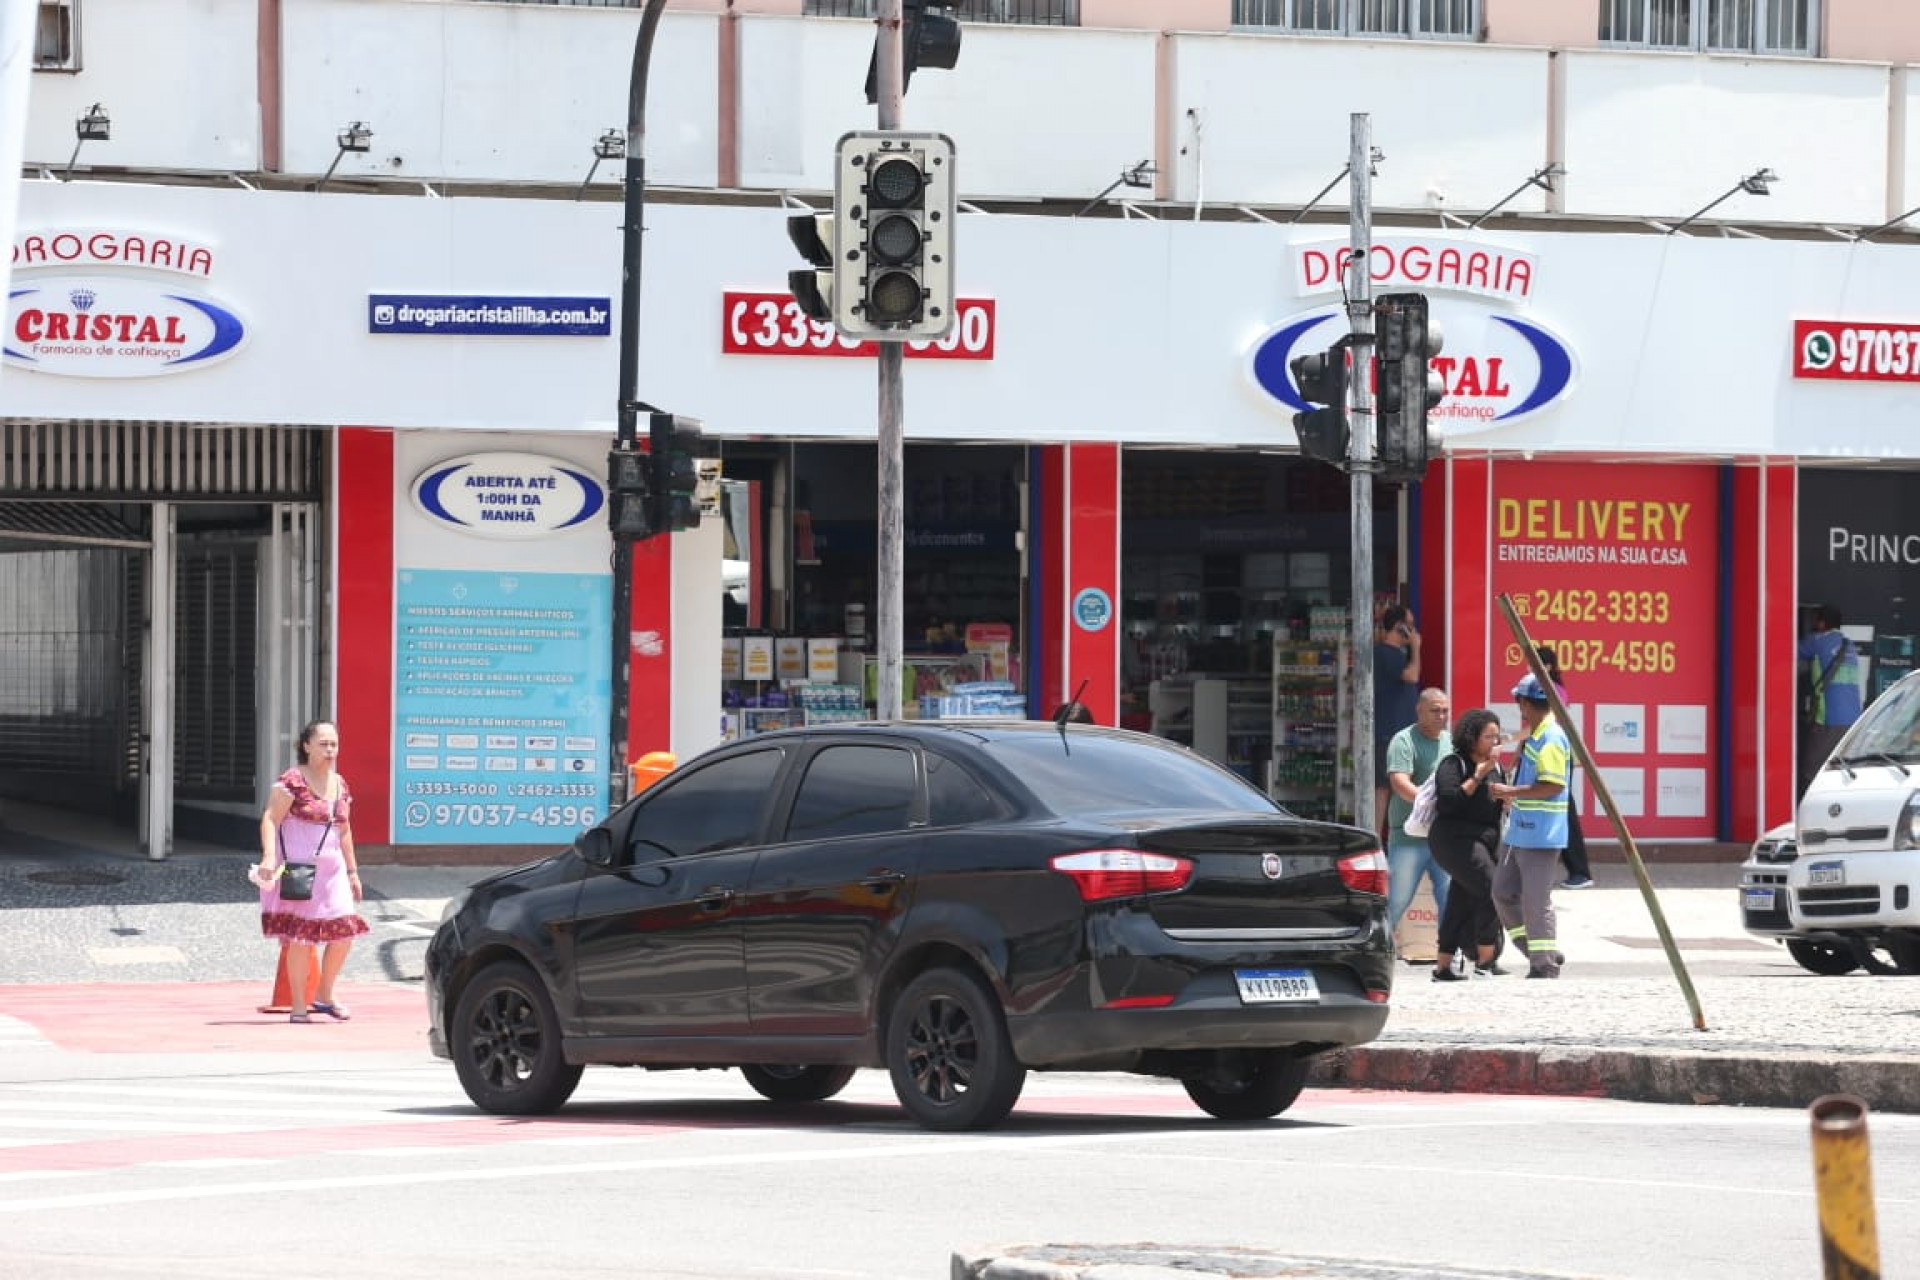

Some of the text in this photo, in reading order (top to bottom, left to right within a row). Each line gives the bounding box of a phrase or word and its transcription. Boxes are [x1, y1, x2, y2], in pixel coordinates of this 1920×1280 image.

[12, 234, 212, 275] ROGARIA
[15, 308, 187, 343] CRISTAL
[398, 304, 608, 328] drogariacristalilha.com.br
[96, 344, 113, 356] de
[118, 345, 181, 361] confiança
[465, 474, 557, 489] ABERTA ATÉ
[477, 492, 541, 505] 1:00H DA
[481, 508, 536, 522] MANHÃ
[1498, 497, 1691, 542] DELIVERY
[1498, 544, 1688, 565] ENTREGAMOS NA SUA CASA
[1534, 589, 1670, 624] 2462-3333
[416, 782, 596, 797] 3393-5000 2462-3333
[435, 803, 596, 827] 97037-4596
